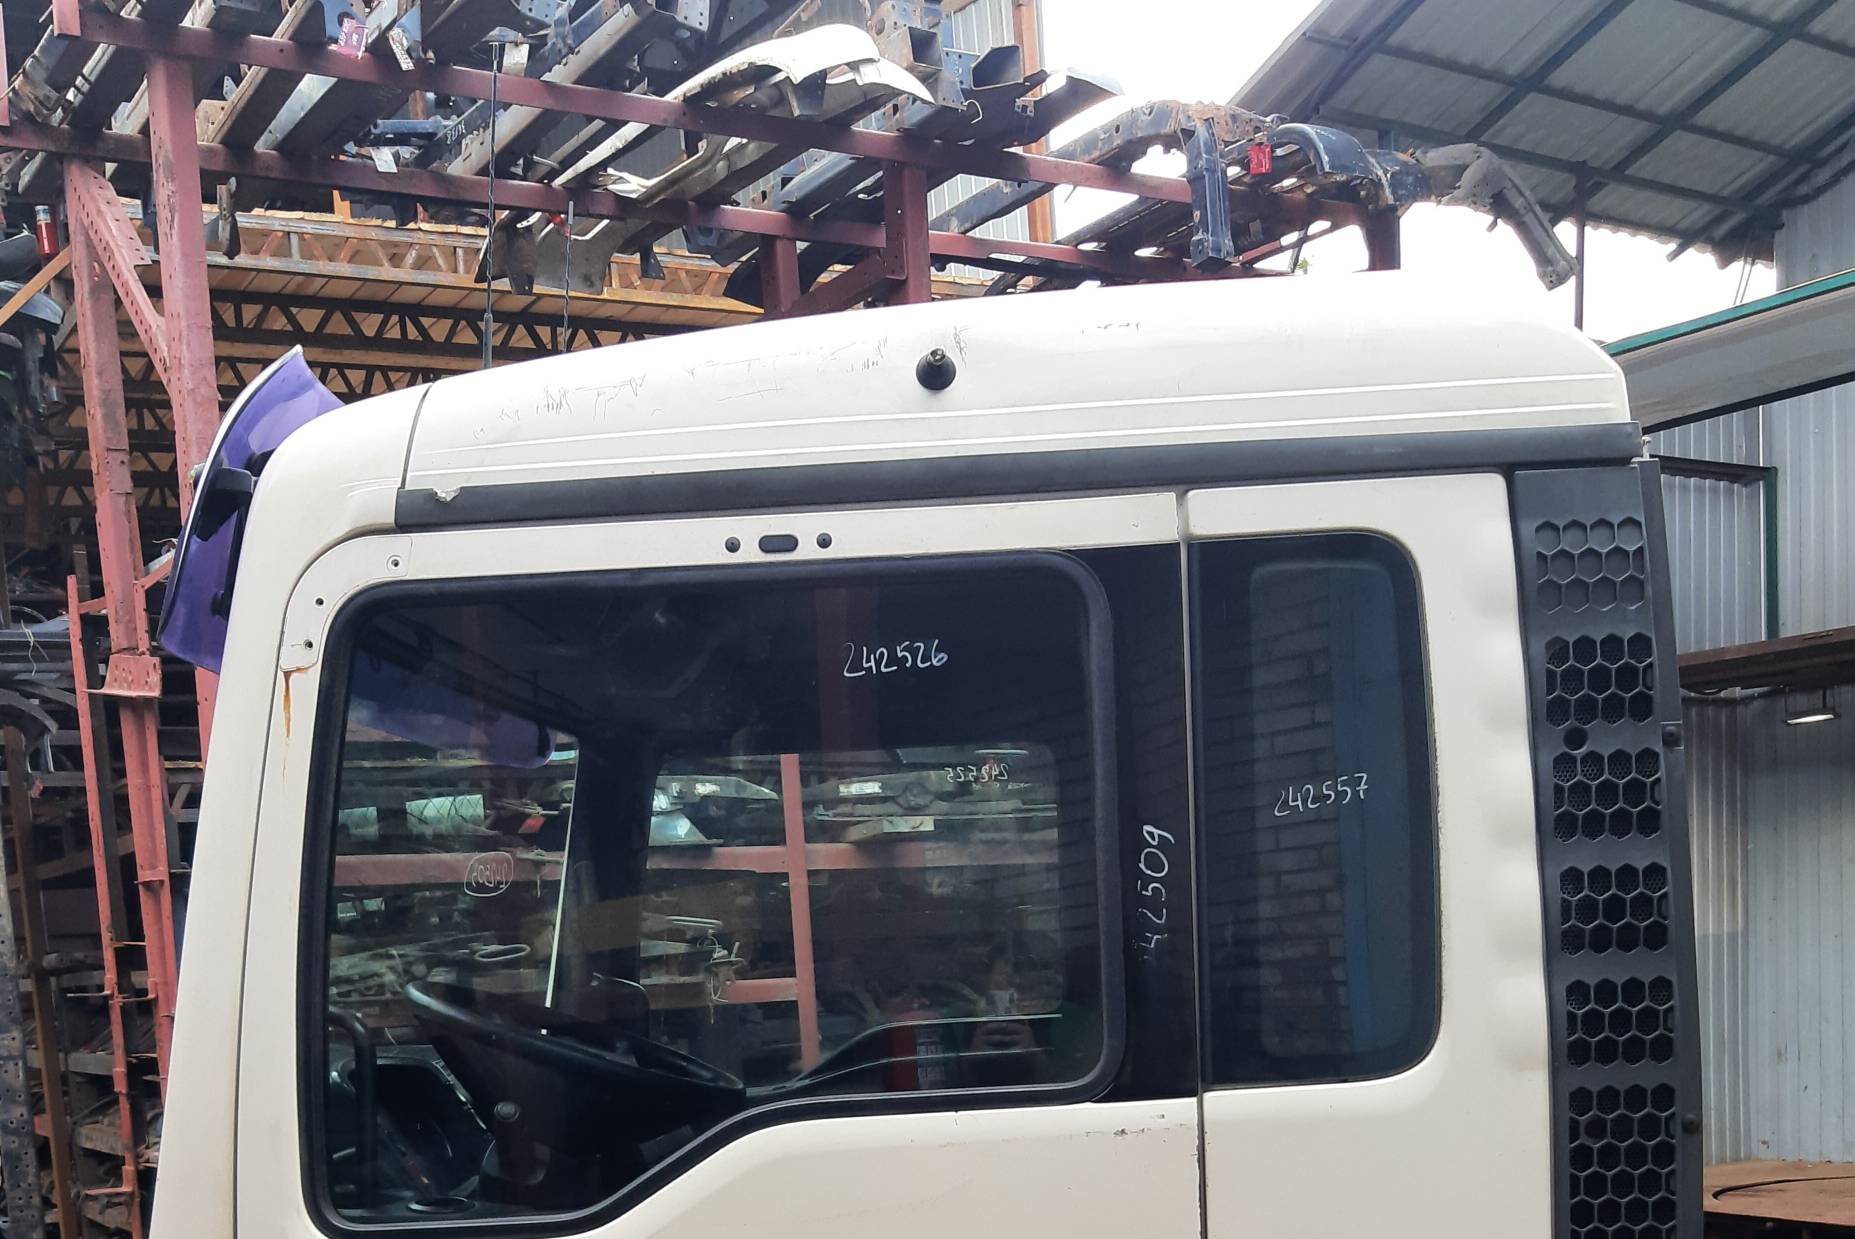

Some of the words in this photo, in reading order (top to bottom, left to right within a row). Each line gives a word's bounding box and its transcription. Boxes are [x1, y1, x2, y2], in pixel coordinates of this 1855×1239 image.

[843, 639, 949, 677] 242526
[1274, 773, 1369, 816] 242557
[1138, 825, 1175, 958] 42509
